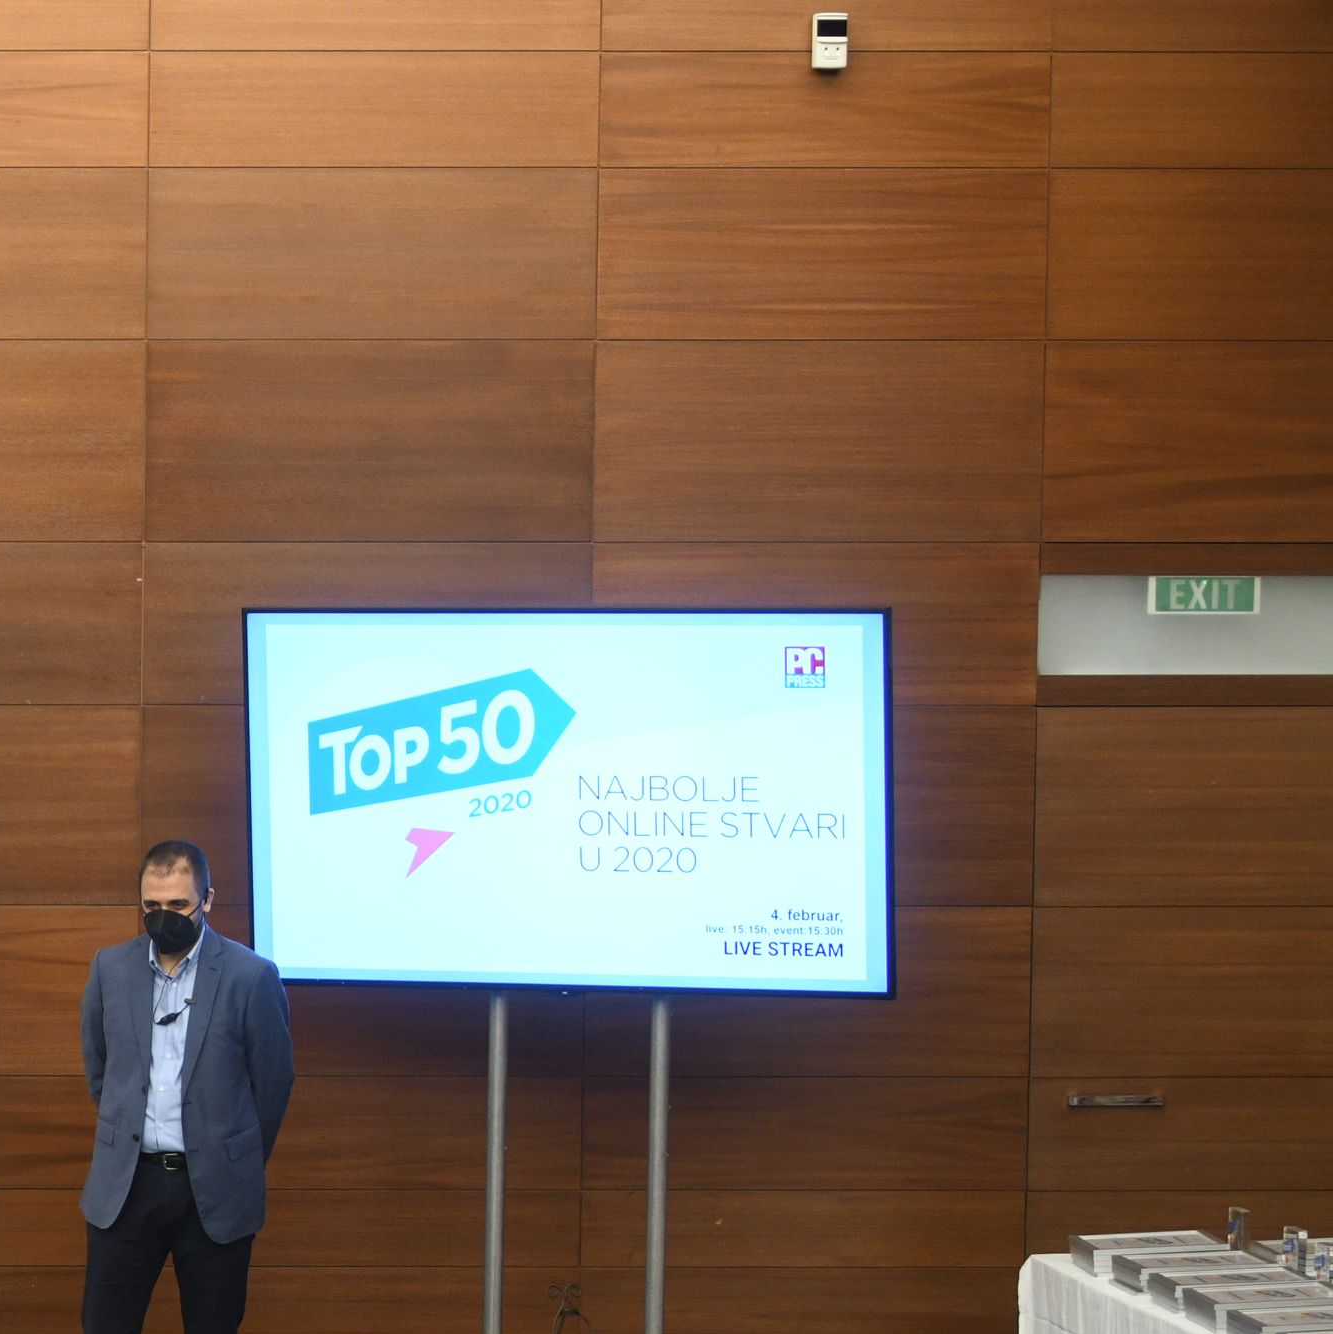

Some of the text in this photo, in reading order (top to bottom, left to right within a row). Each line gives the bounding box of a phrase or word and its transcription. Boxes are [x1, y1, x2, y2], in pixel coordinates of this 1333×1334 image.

[1169, 579, 1241, 611] EXIT
[787, 648, 823, 675] PC
[787, 675, 823, 688] PRESS
[319, 689, 535, 796] TOP 50
[578, 774, 760, 803] NAJBOLJE
[469, 790, 532, 818] 2020
[578, 810, 846, 840] ONLINE STVARI
[578, 846, 697, 874] U 2020
[770, 908, 843, 924] 4. februar,
[723, 941, 844, 957] LIVE STREAM
